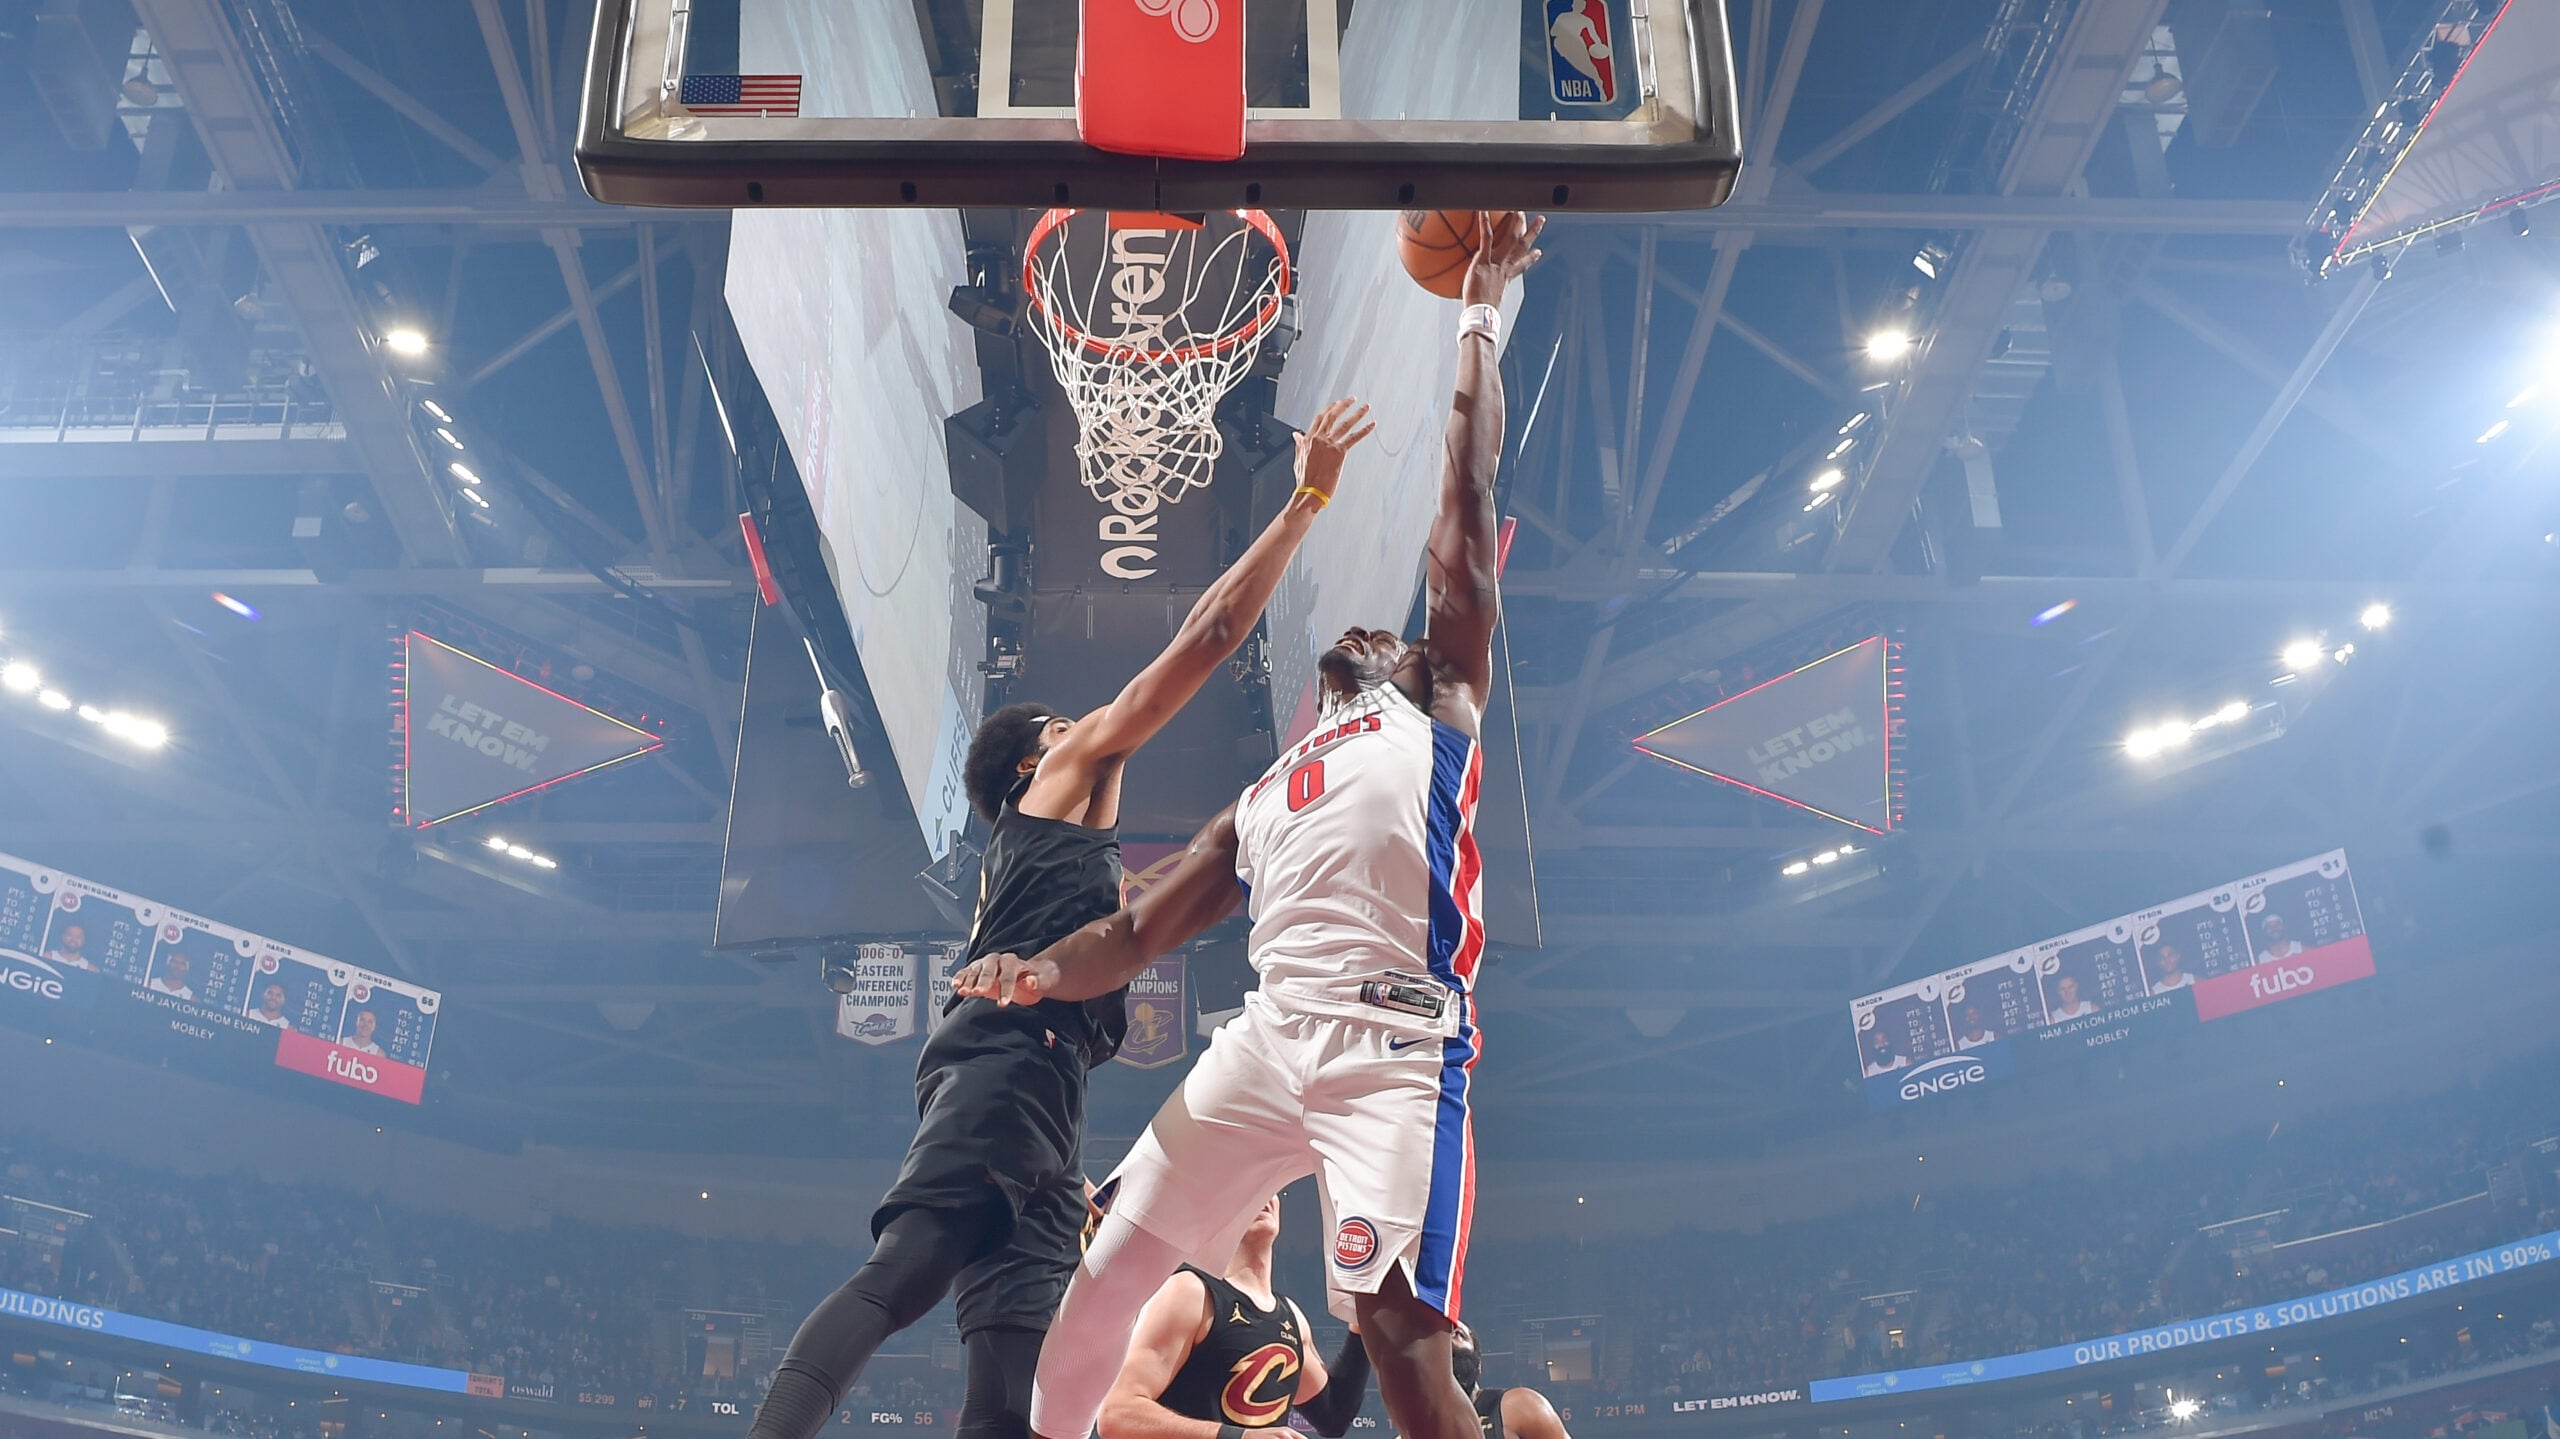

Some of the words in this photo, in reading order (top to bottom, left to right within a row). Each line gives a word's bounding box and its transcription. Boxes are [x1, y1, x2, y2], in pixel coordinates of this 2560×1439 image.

[1560, 80, 1592, 98] NBA
[1109, 228, 1166, 364] Aren
[440, 694, 502, 729] LET
[501, 722, 550, 752] EM
[1747, 728, 1802, 765] LET
[1806, 707, 1857, 739] EM
[942, 711, 967, 813] CLIFFS
[1287, 760, 1324, 812] 0
[2242, 877, 2266, 889] ALLEN
[2322, 859, 2340, 872] 31
[66, 879, 119, 900] CUNNINGHAM
[145, 908, 152, 917] 2
[2138, 910, 2162, 921] TYSON
[2213, 893, 2231, 906] 20
[170, 911, 210, 930] THOMPSON
[858, 947, 904, 960] 006-0
[2039, 938, 2070, 952] MERRILL
[266, 942, 292, 956] HARRIS
[334, 968, 346, 979] 12
[1946, 968, 1973, 981] MOBLEY
[2017, 956, 2025, 965] 4
[358, 972, 392, 987] ROBINSON
[856, 965, 904, 977] EASTERN
[853, 980, 913, 991] ONFERENCE
[1129, 980, 1178, 994] AMPIONS
[2250, 966, 2314, 998] fubo
[846, 995, 909, 1007] CHAMPIONS
[1856, 996, 1883, 1008] HARDEN
[131, 989, 154, 1004] HAM
[157, 996, 198, 1017] JAYLON
[201, 1009, 230, 1026] FROM
[233, 1018, 261, 1035] EVAN
[2040, 1028, 2062, 1040] HAM
[2064, 1015, 2105, 1034] JAYLON
[2108, 1004, 2139, 1021] FROM
[2142, 997, 2171, 1013] EVAN
[171, 1020, 215, 1040] MOBLEY
[2086, 1028, 2130, 1048] MOBLEY
[325, 1050, 378, 1084] fubo
[1337, 1242, 1367, 1254] PISTONS
[1340, 1233, 1369, 1244] DETROIT
[0, 1292, 104, 1328] UILDINGS
[2075, 1341, 2122, 1364] OUR
[2128, 1316, 2248, 1355] PRODUCTS
[2254, 1312, 2272, 1330] &
[2277, 1279, 2410, 1326] SOLUTIONS
[2417, 1265, 2460, 1293] ARE
[2465, 1255, 2494, 1280] IN
[2500, 1243, 2550, 1270] 90%
[511, 1384, 554, 1398] oswald
[1673, 1399, 1708, 1412] LET
[1711, 1397, 1738, 1409] EM
[1739, 1389, 1801, 1407] KNOW.
[712, 1402, 740, 1416] TOL
[842, 1411, 851, 1424] 2
[871, 1412, 903, 1425] FG%
[914, 1412, 933, 1425] 56
[1594, 1405, 1621, 1418] 7:21
[1625, 1404, 1646, 1416] PM
[1352, 1416, 1376, 1429] G%
